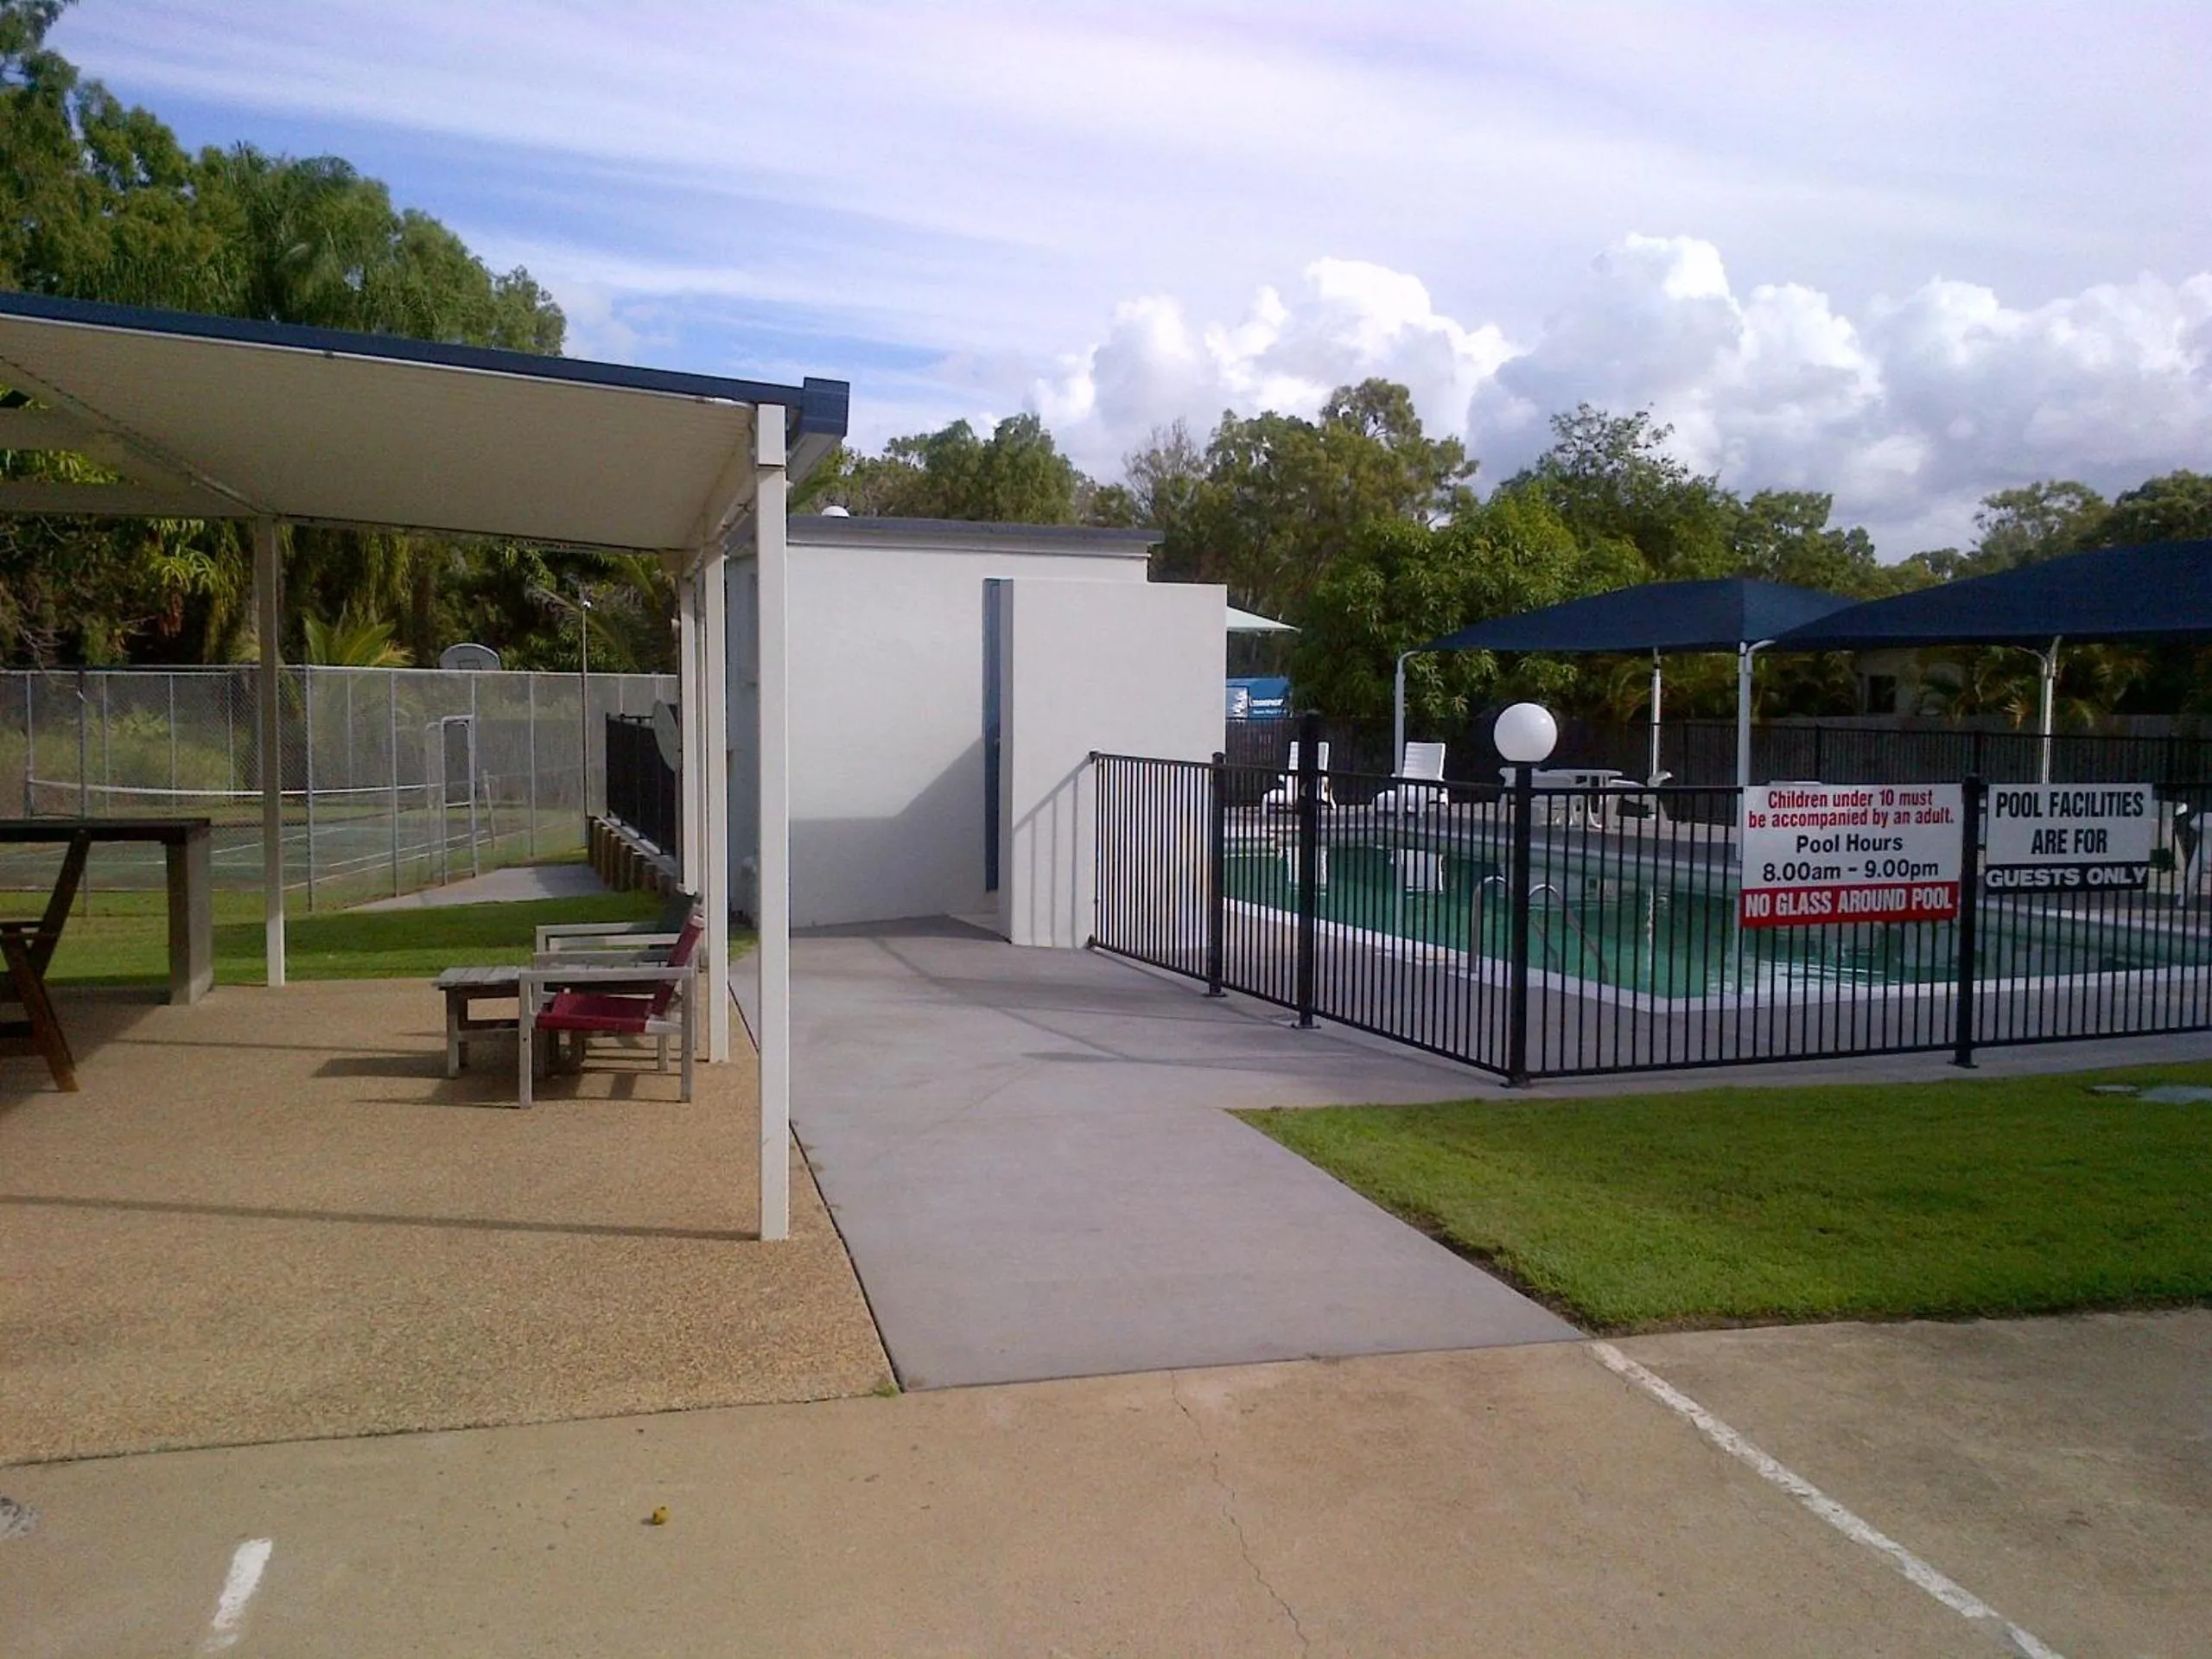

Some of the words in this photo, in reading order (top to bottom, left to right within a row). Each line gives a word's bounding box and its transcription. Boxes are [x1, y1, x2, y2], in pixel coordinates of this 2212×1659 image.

[1768, 791, 1827, 809] Children
[1833, 790, 1873, 807] under
[1879, 789, 1894, 806] 10
[1899, 790, 1933, 805] must
[1996, 791, 2043, 817] POOL
[2049, 791, 2144, 817] FACILITIES
[1748, 810, 1766, 828] be
[1772, 809, 1867, 830] accompanied
[1872, 809, 1888, 828] by
[1893, 810, 1910, 824] an
[1915, 807, 1955, 823] adult.
[1796, 834, 1840, 853] Pool
[1847, 833, 1903, 852] Hours
[2031, 829, 2068, 855] ARE
[2074, 829, 2107, 854] FOR
[1763, 861, 1840, 881] 8.00am
[1865, 859, 1938, 880] 9.00pm
[1986, 868, 2080, 887] GUESTS
[2086, 866, 2148, 885] ONLY
[1745, 893, 1770, 918] NO
[1776, 891, 1832, 916] GLASS
[1837, 887, 1907, 913] AROUND
[1911, 887, 1953, 910] POOL
